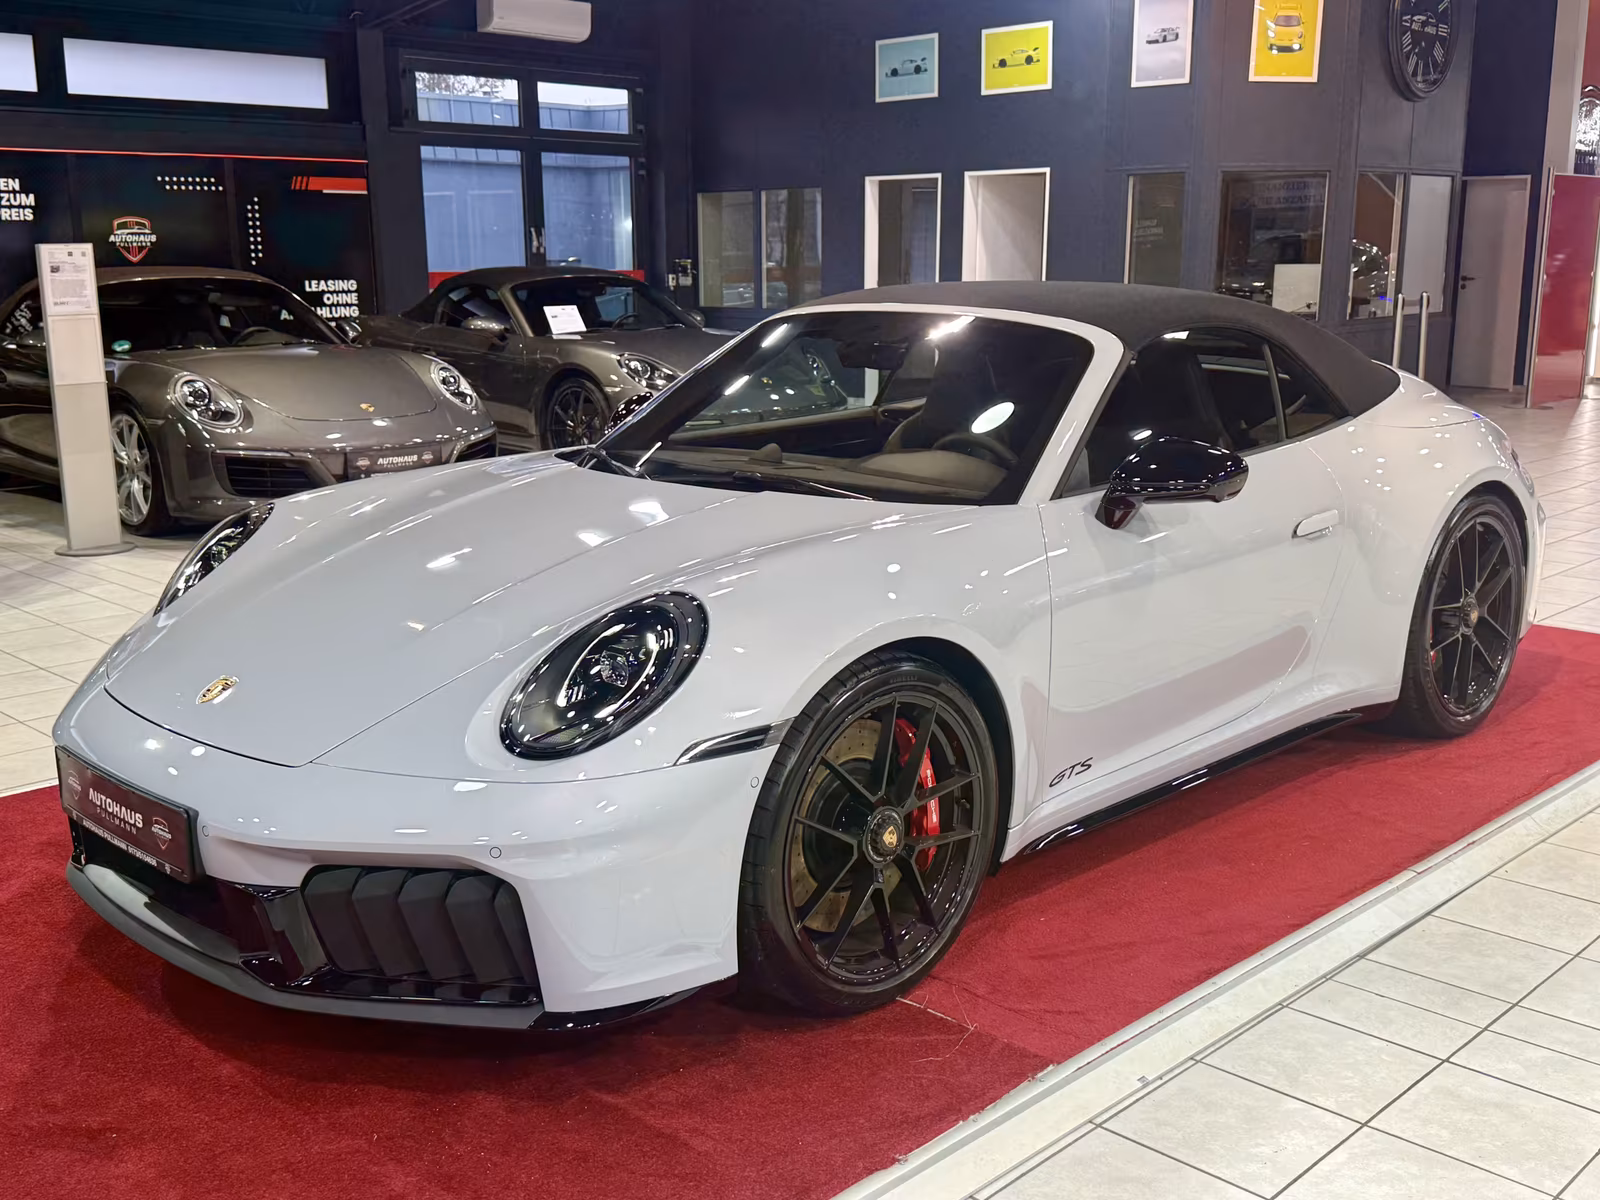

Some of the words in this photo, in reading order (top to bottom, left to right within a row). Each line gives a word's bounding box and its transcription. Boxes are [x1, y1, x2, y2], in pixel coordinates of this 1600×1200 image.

[0, 178, 20, 191] EN
[0, 193, 35, 206] ZUM
[0, 208, 34, 221] REIS
[109, 234, 157, 242] AUTOHAUS
[304, 280, 357, 292] LEASING
[323, 292, 359, 305] OHNE
[377, 454, 418, 465] AUTOHAUS
[1049, 757, 1093, 788] GTS
[88, 787, 144, 829] AUTOHAUS
[96, 806, 137, 836] PULLMANN
